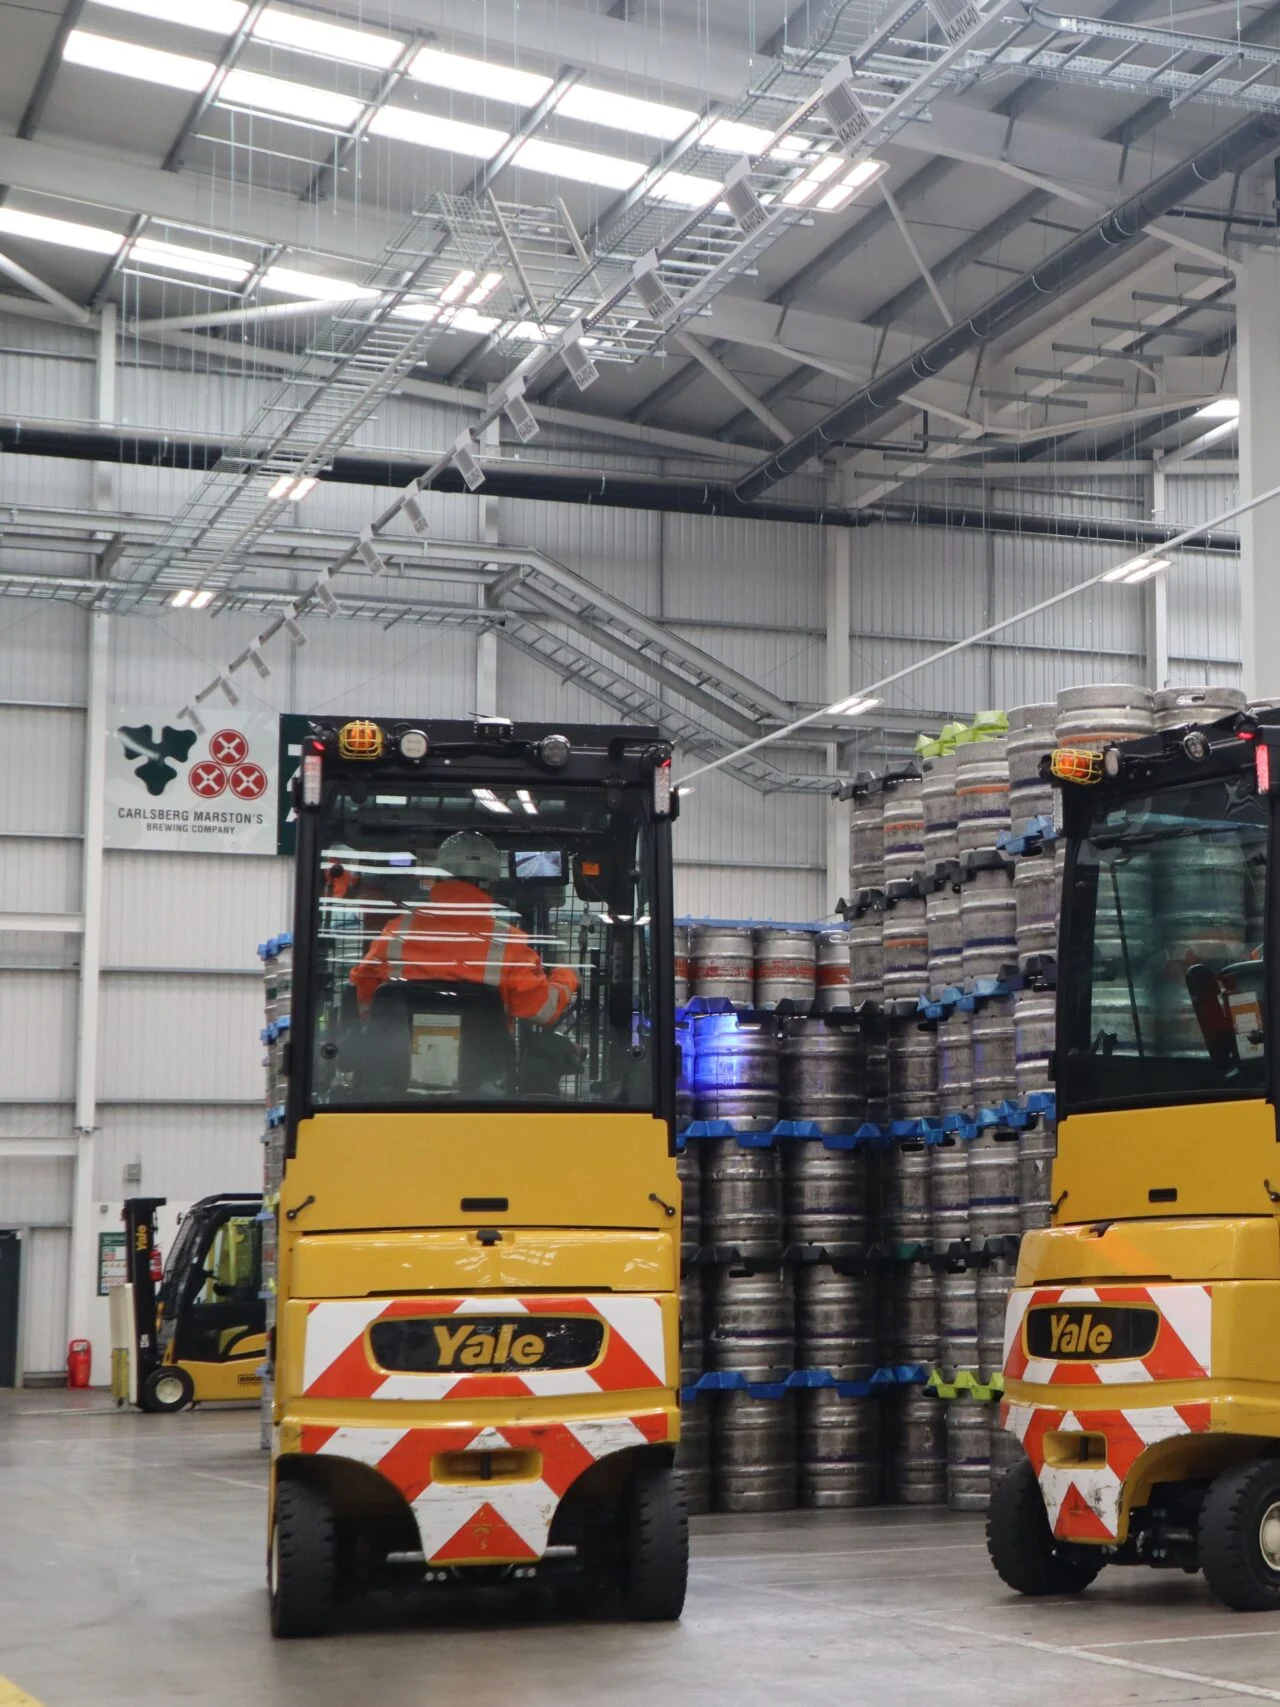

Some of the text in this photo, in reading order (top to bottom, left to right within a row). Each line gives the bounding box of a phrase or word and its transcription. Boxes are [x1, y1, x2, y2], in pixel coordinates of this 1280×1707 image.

[944, 5, 980, 45] KA-014-01
[118, 807, 263, 825] CARLSBERG MARSTON'S
[146, 823, 235, 835] BREWING COMPANY
[433, 1324, 545, 1365] Yale
[1050, 1314, 1112, 1353] Yale
